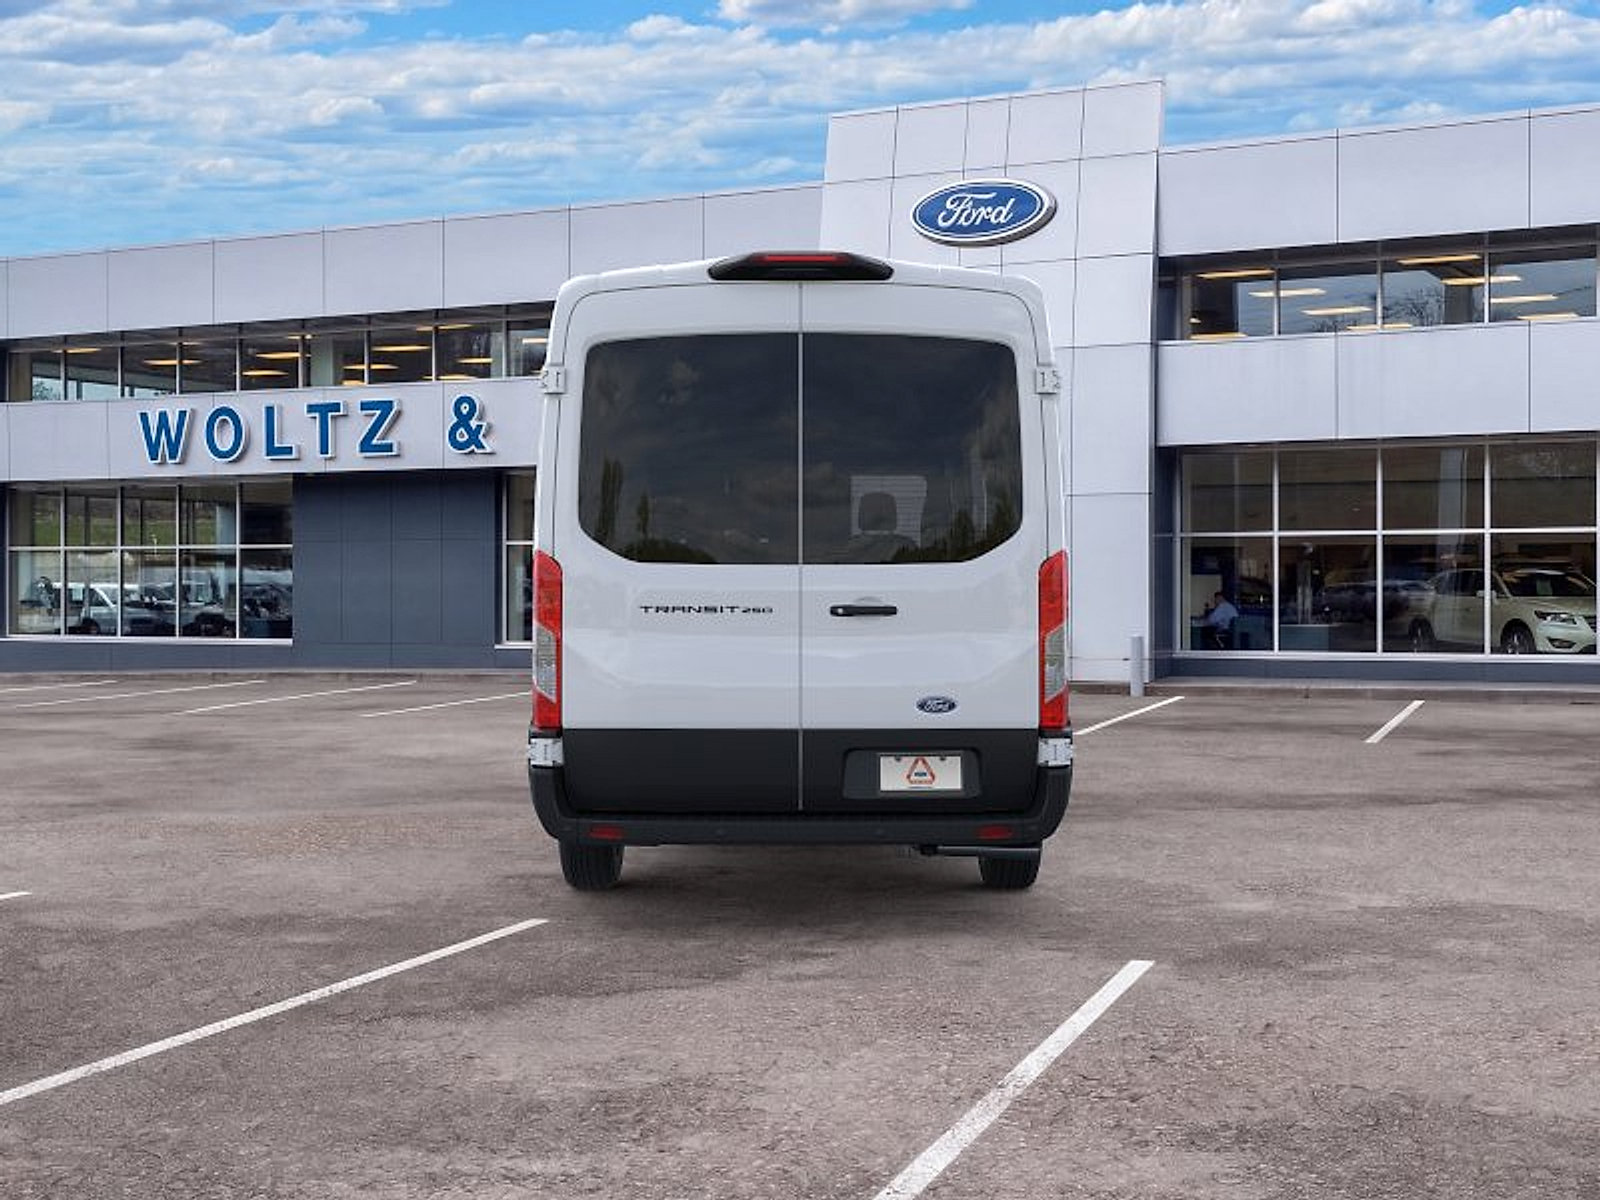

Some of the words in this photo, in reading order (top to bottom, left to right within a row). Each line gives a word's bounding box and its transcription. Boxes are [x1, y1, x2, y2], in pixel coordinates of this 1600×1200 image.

[937, 192, 1015, 227] Ford
[138, 399, 401, 465] WOLTZ
[447, 395, 494, 455] &
[639, 605, 739, 614] TRANSIT
